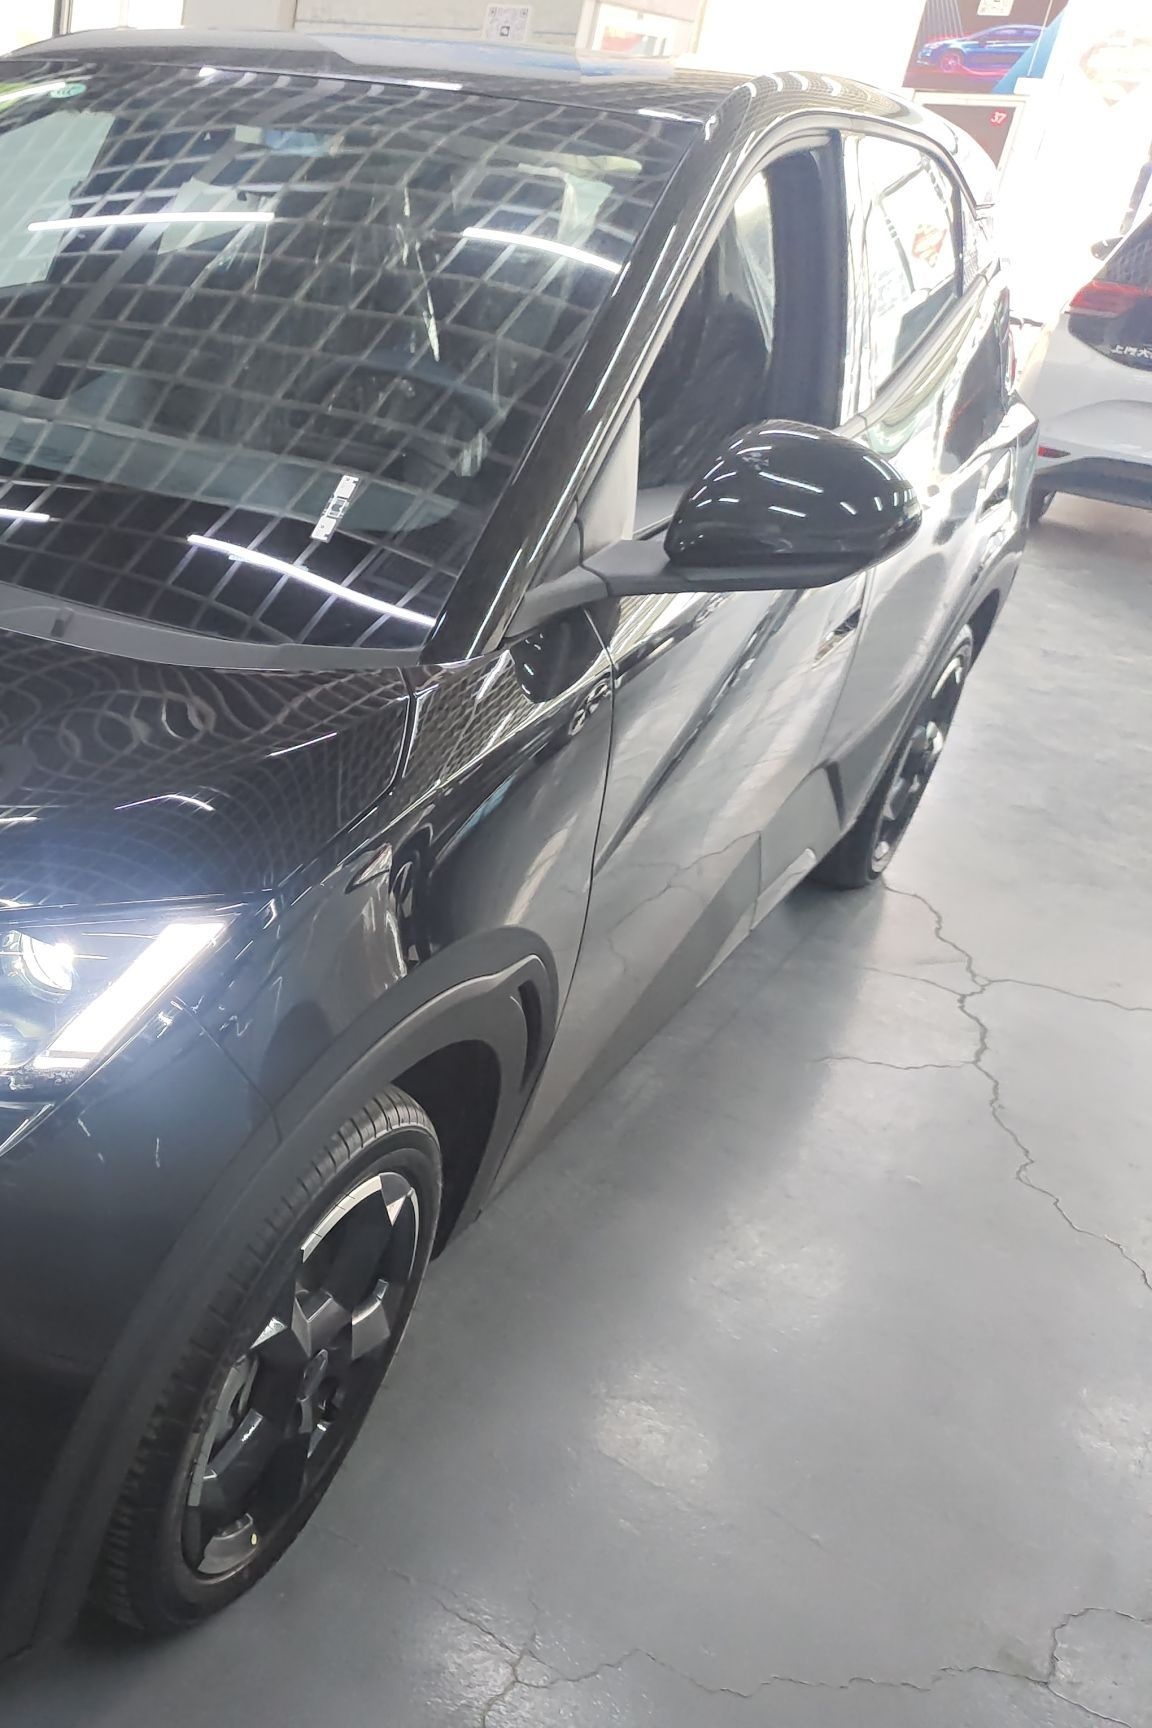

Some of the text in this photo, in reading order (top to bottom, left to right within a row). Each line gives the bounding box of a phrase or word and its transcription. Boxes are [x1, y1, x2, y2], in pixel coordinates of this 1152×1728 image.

[990, 111, 1007, 124] 37
[1110, 344, 1152, 360] 上汽大
